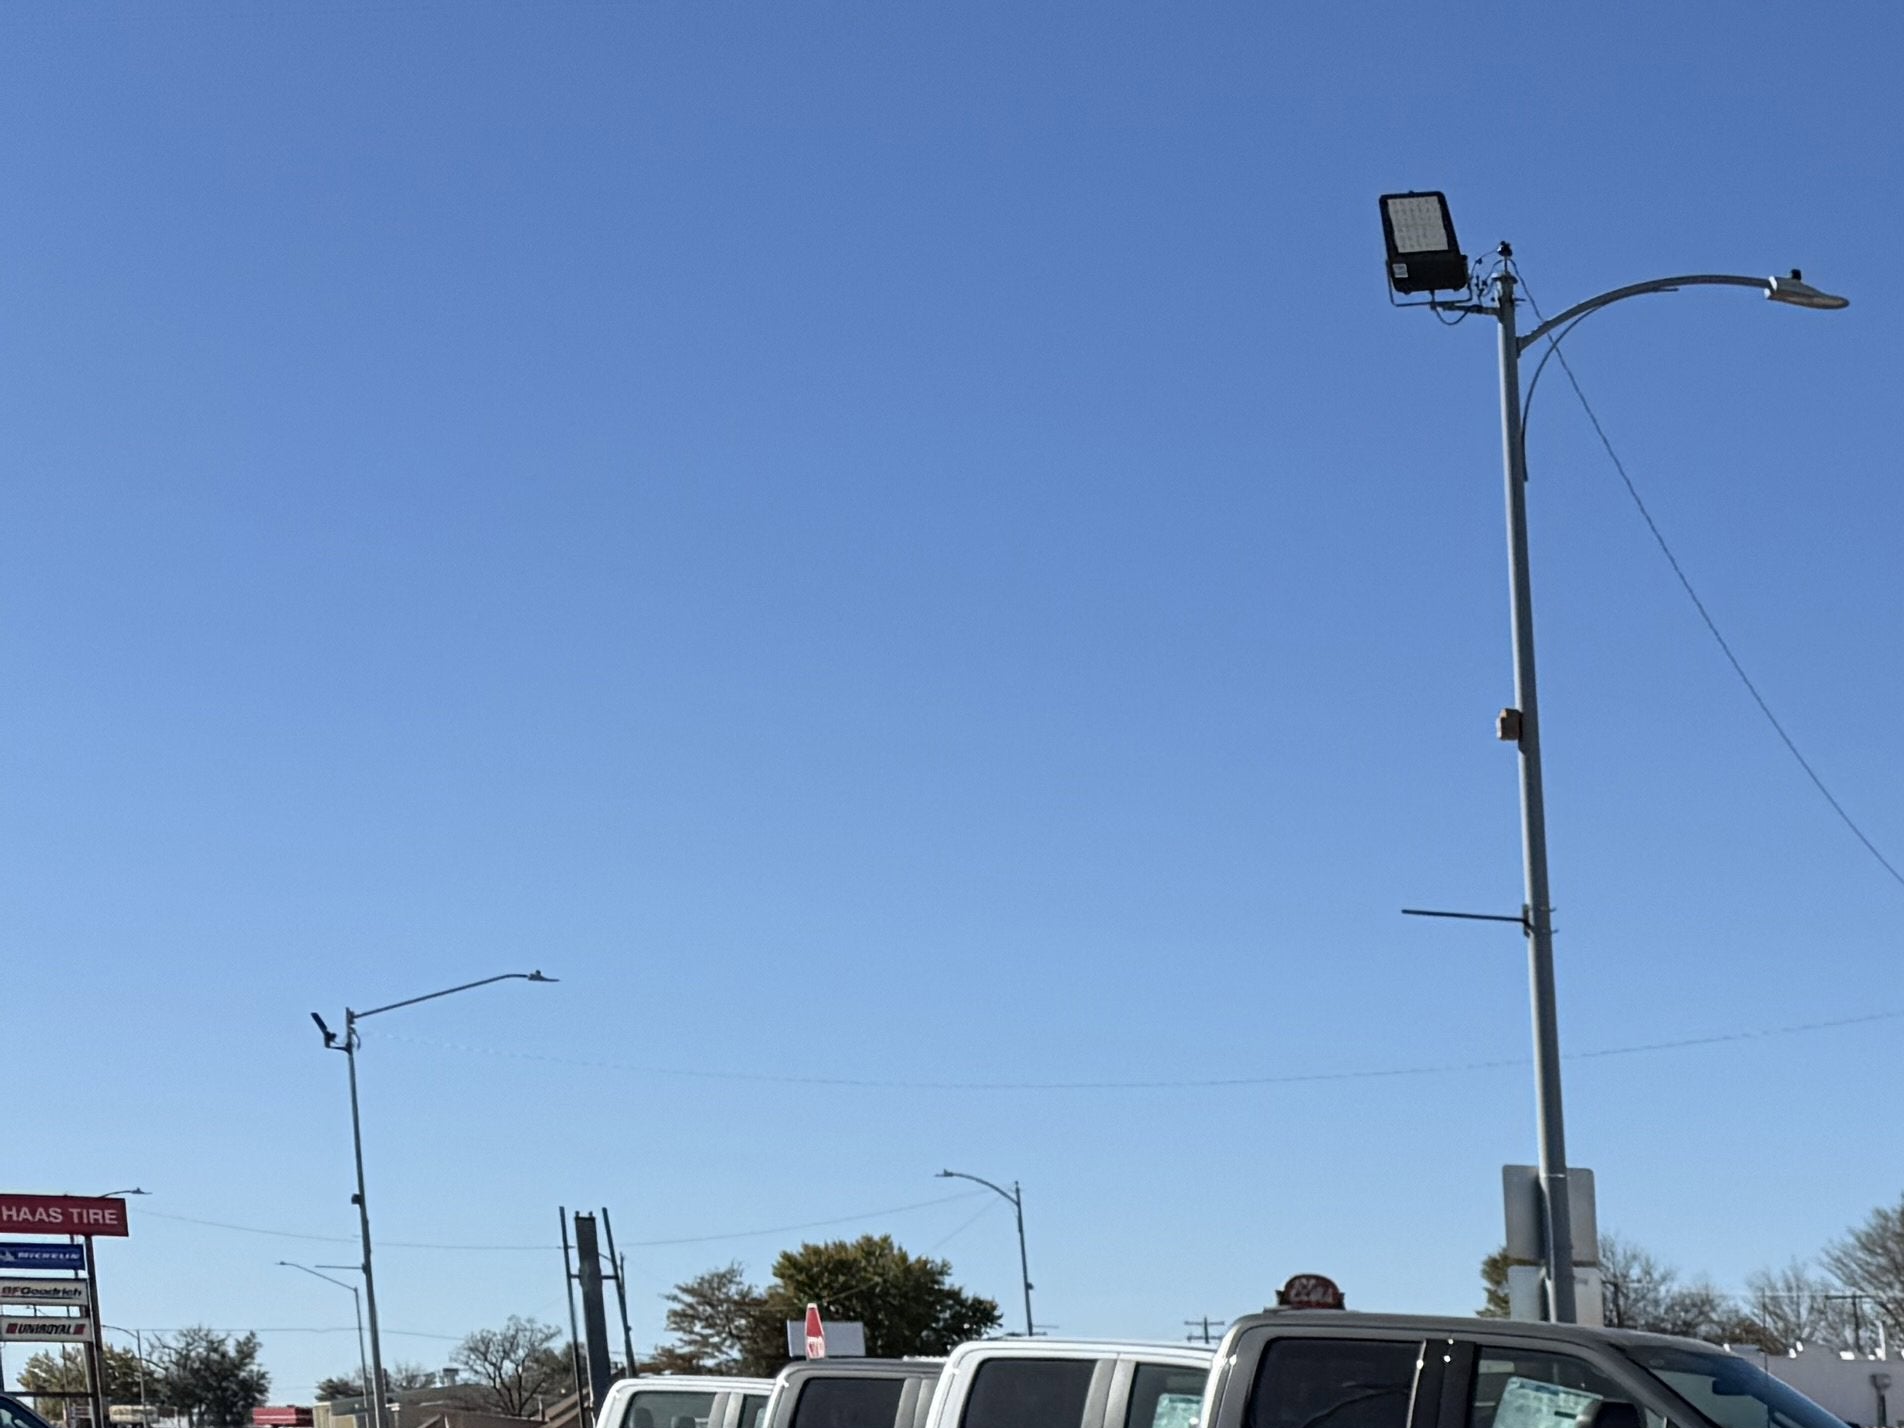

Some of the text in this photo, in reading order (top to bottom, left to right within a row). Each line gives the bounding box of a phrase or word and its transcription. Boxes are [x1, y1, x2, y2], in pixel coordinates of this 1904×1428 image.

[2, 1206, 118, 1225] HAAS TIRE
[18, 1252, 80, 1260] MICHELIN
[1, 1285, 82, 1297] BFGoodrich
[18, 1324, 72, 1335] UNIROYAL
